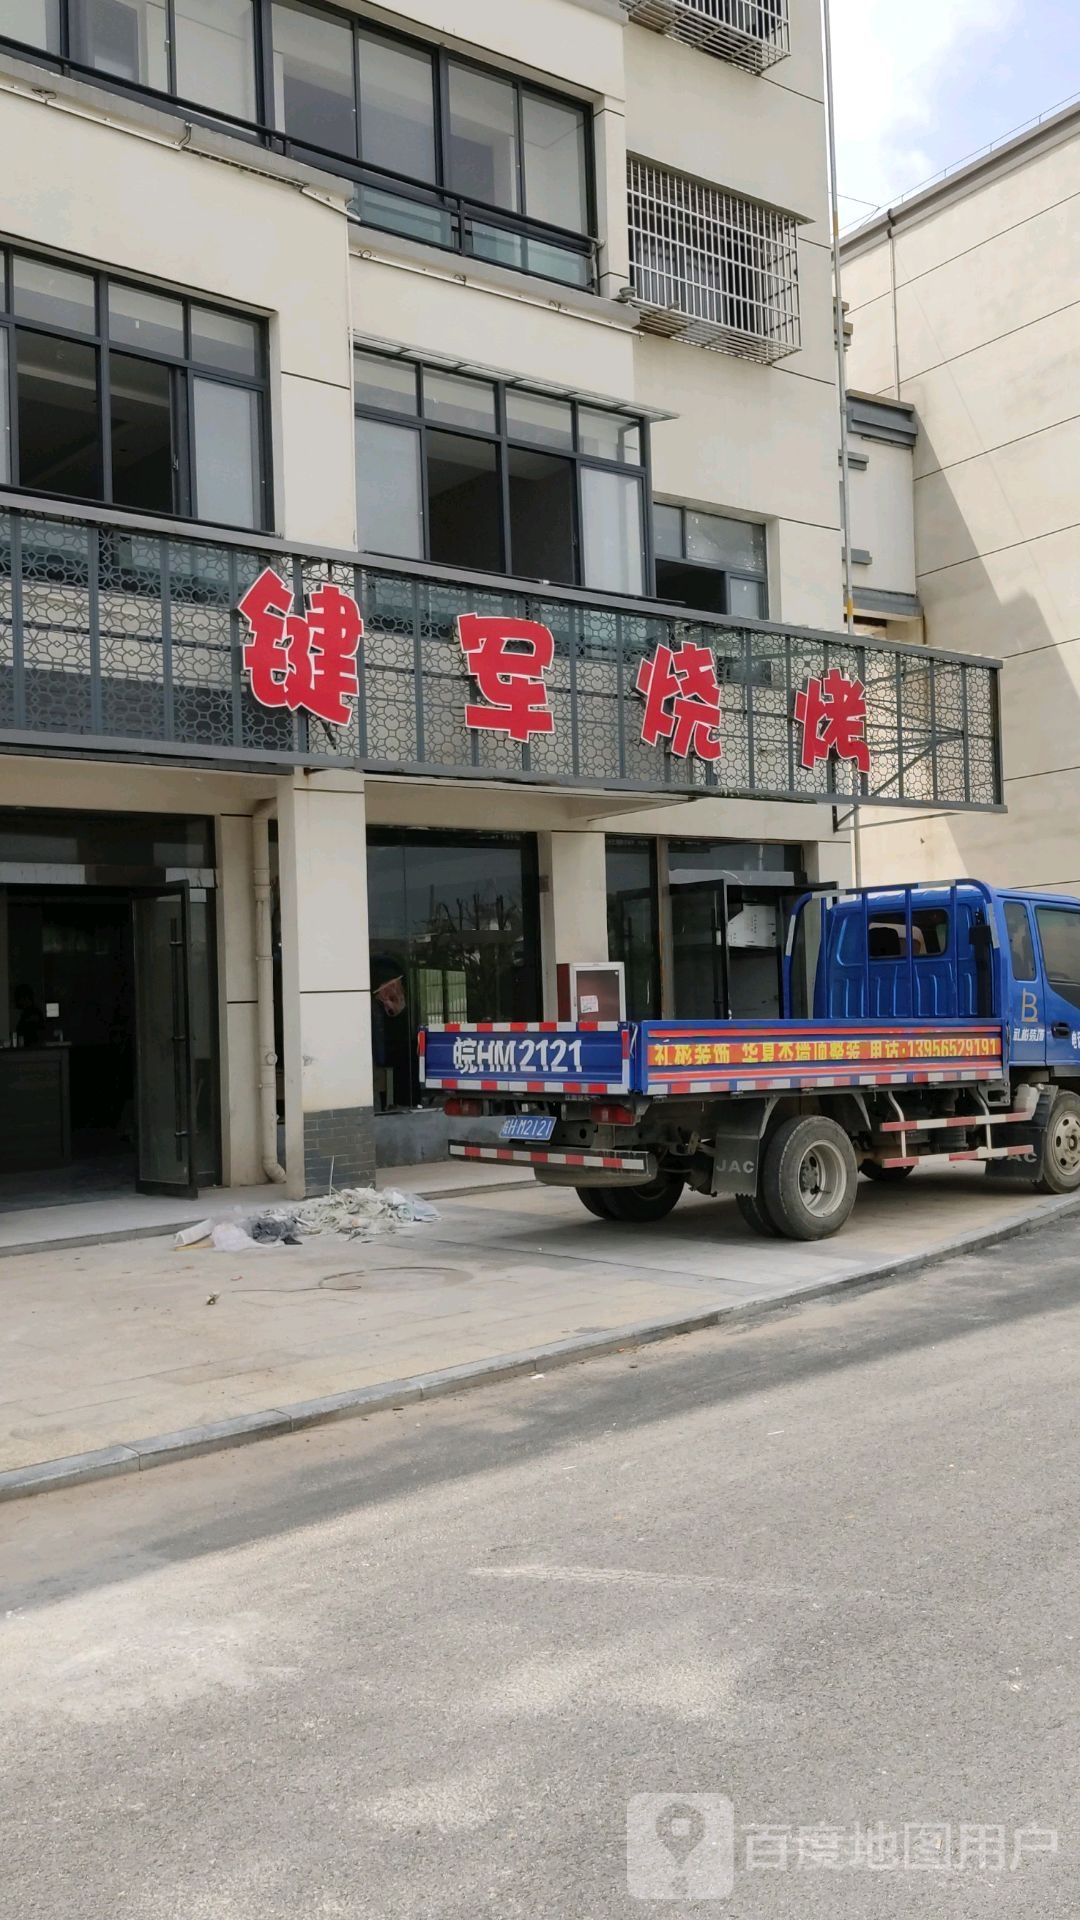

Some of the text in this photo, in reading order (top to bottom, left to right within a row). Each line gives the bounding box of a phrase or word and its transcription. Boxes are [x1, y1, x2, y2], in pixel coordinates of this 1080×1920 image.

[238, 567, 871, 773] 键军烧烤
[452, 1037, 583, 1074] 皖HM2121
[716, 1160, 754, 1173] JAC
